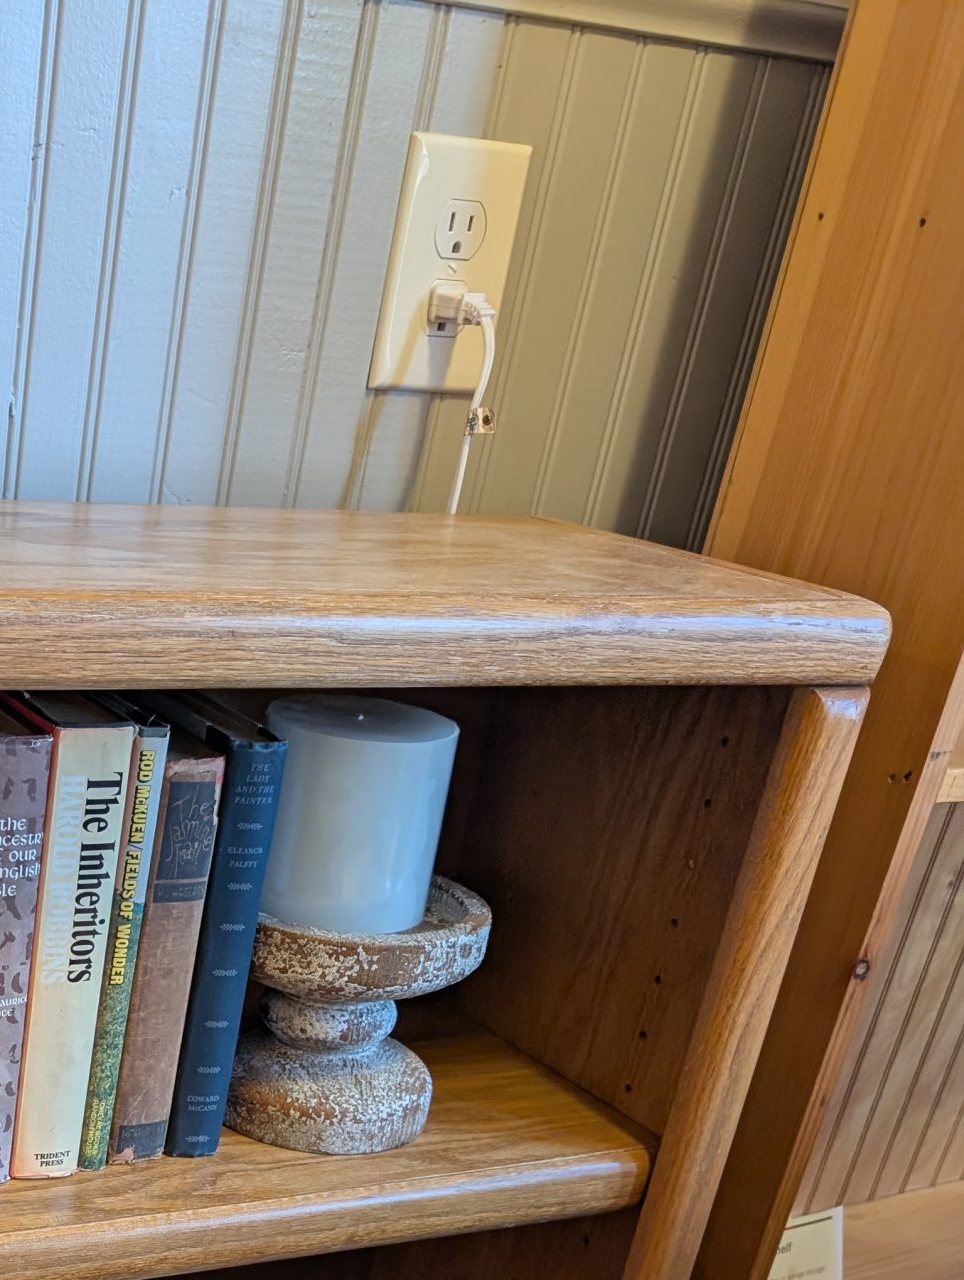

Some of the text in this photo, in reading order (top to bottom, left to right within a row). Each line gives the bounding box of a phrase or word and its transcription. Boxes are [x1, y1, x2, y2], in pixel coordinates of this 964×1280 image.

[137, 750, 155, 783] ROD
[251, 763, 270, 772] THE
[246, 775, 270, 783] LADY
[236, 785, 275, 793] AND THE
[53, 775, 87, 877] HAROLD
[227, 846, 263, 854] ELEANOR
[67, 771, 123, 984] The Inheritors
[122, 850, 141, 900] FIELDS
[119, 901, 134, 920] OF
[108, 923, 131, 986] WONDER
[34, 1149, 71, 1162] TRIDENT
[39, 1158, 65, 1168] PRESS
